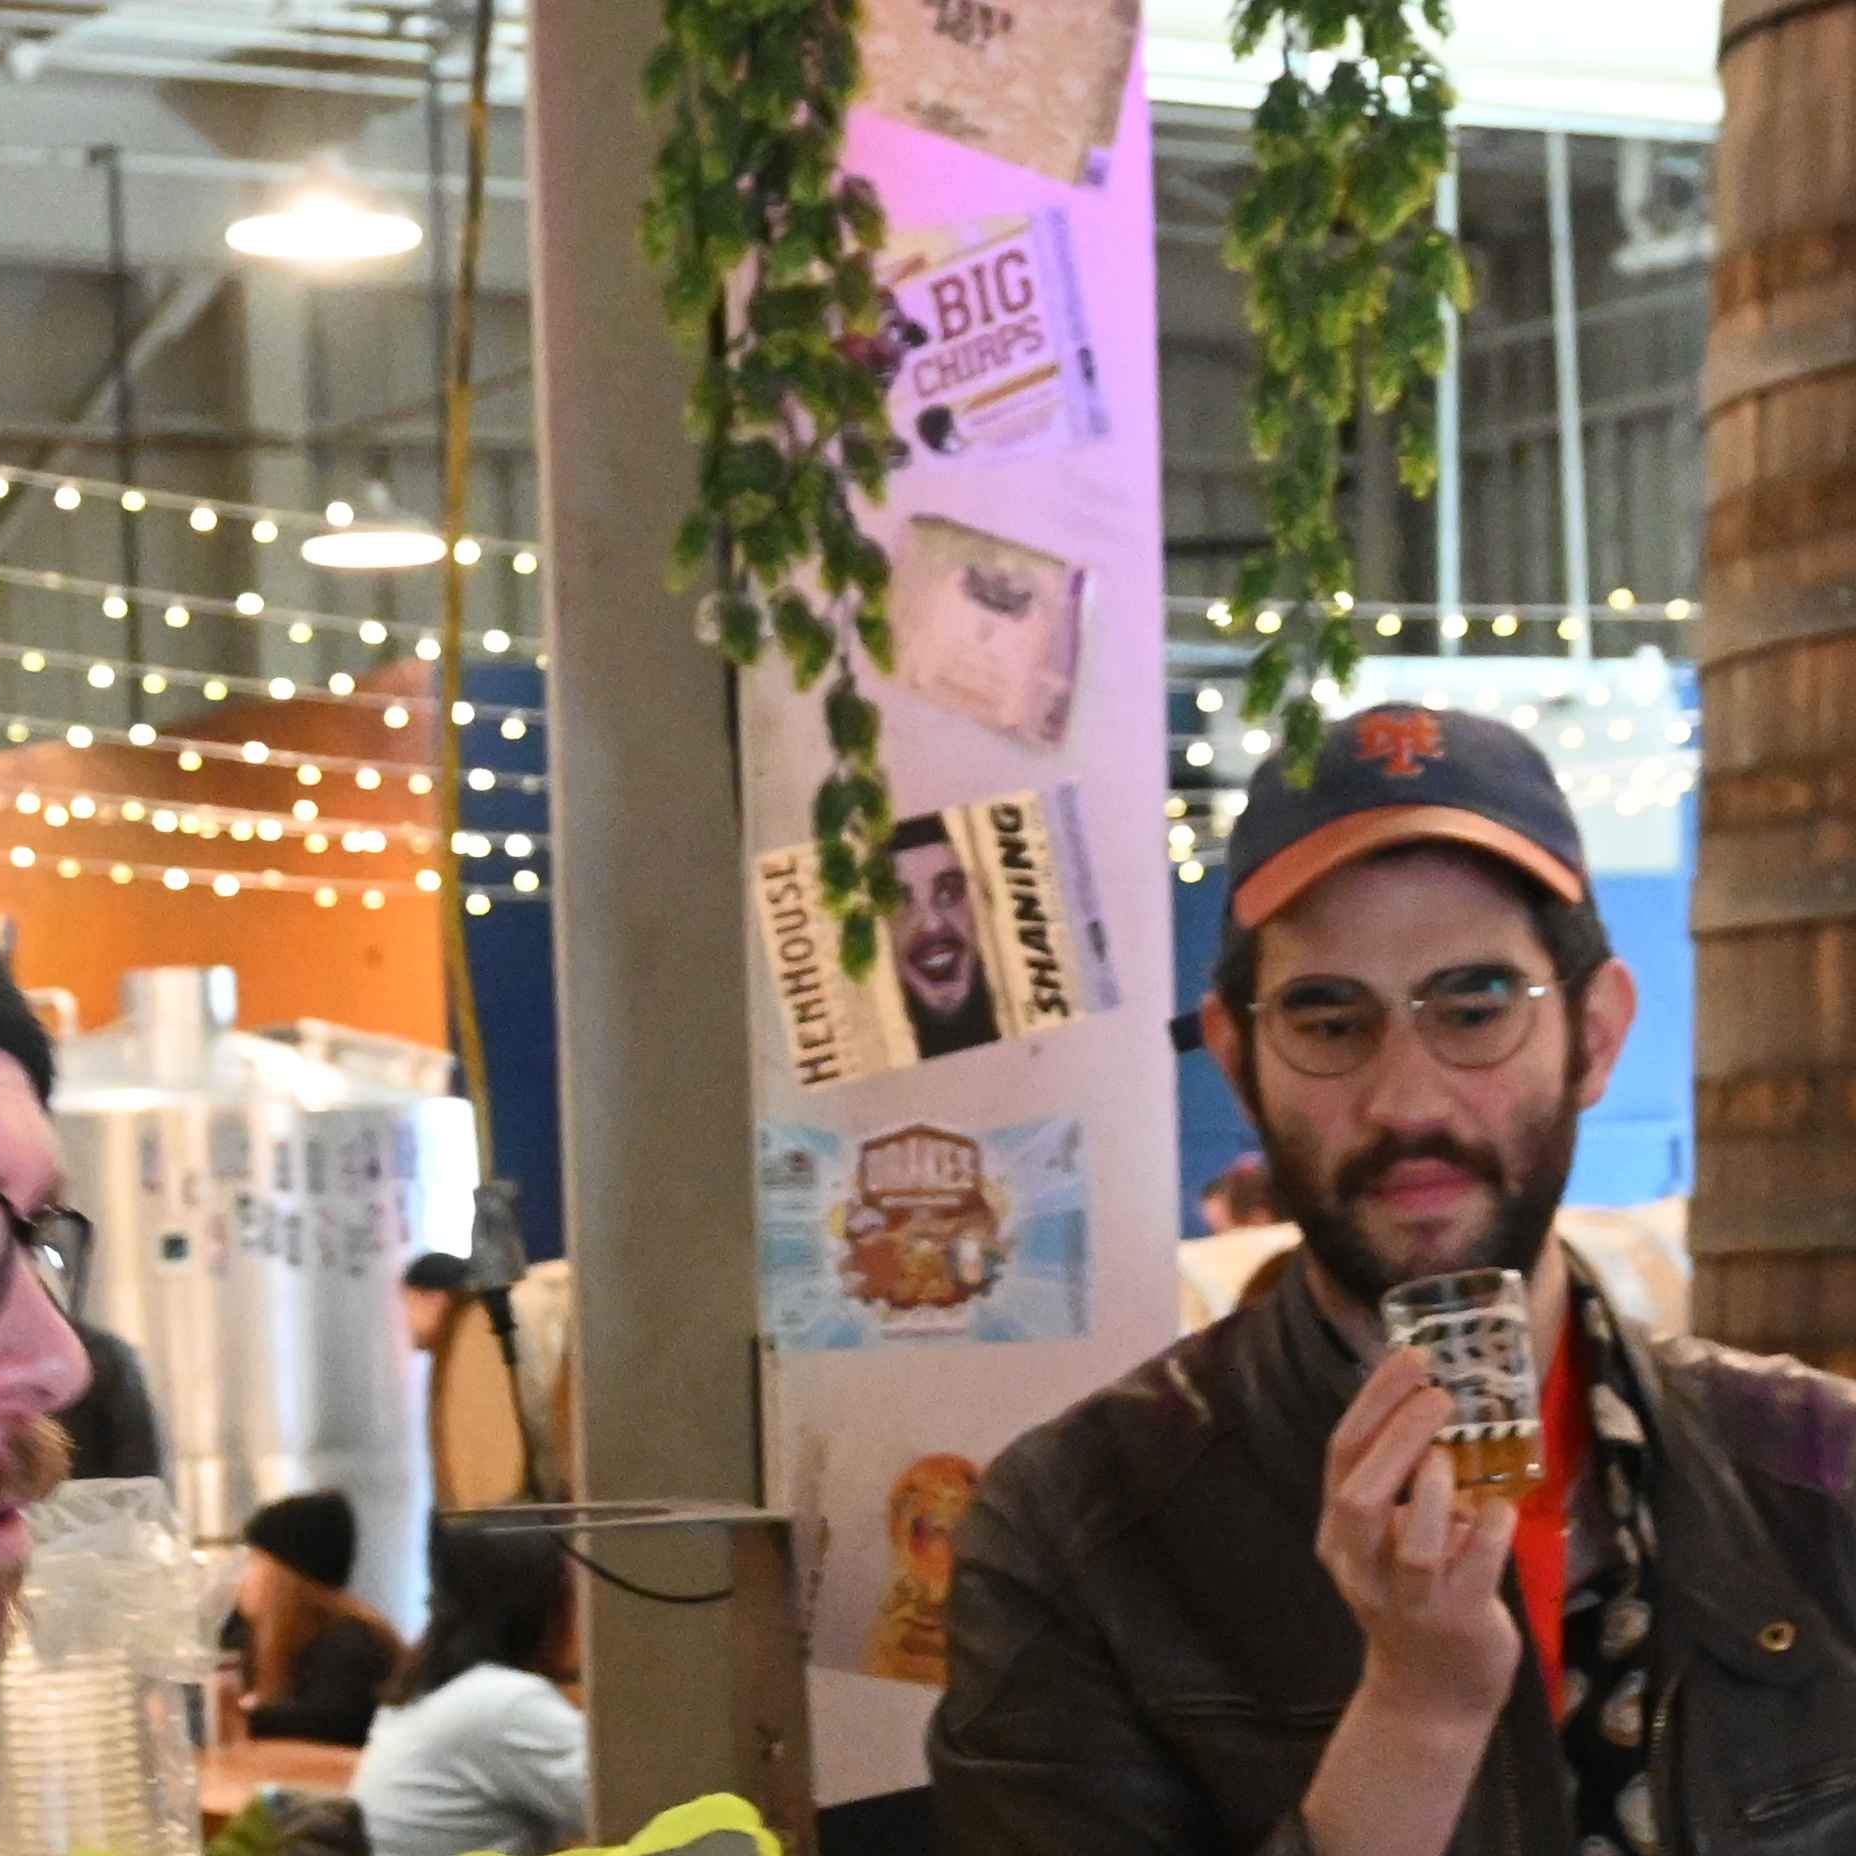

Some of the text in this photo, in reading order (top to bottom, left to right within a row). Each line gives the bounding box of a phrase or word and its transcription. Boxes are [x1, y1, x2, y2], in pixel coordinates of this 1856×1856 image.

[931, 249, 1033, 340] BIG
[912, 313, 1046, 397] CHIRPS
[761, 855, 843, 1085] HENHOUSE
